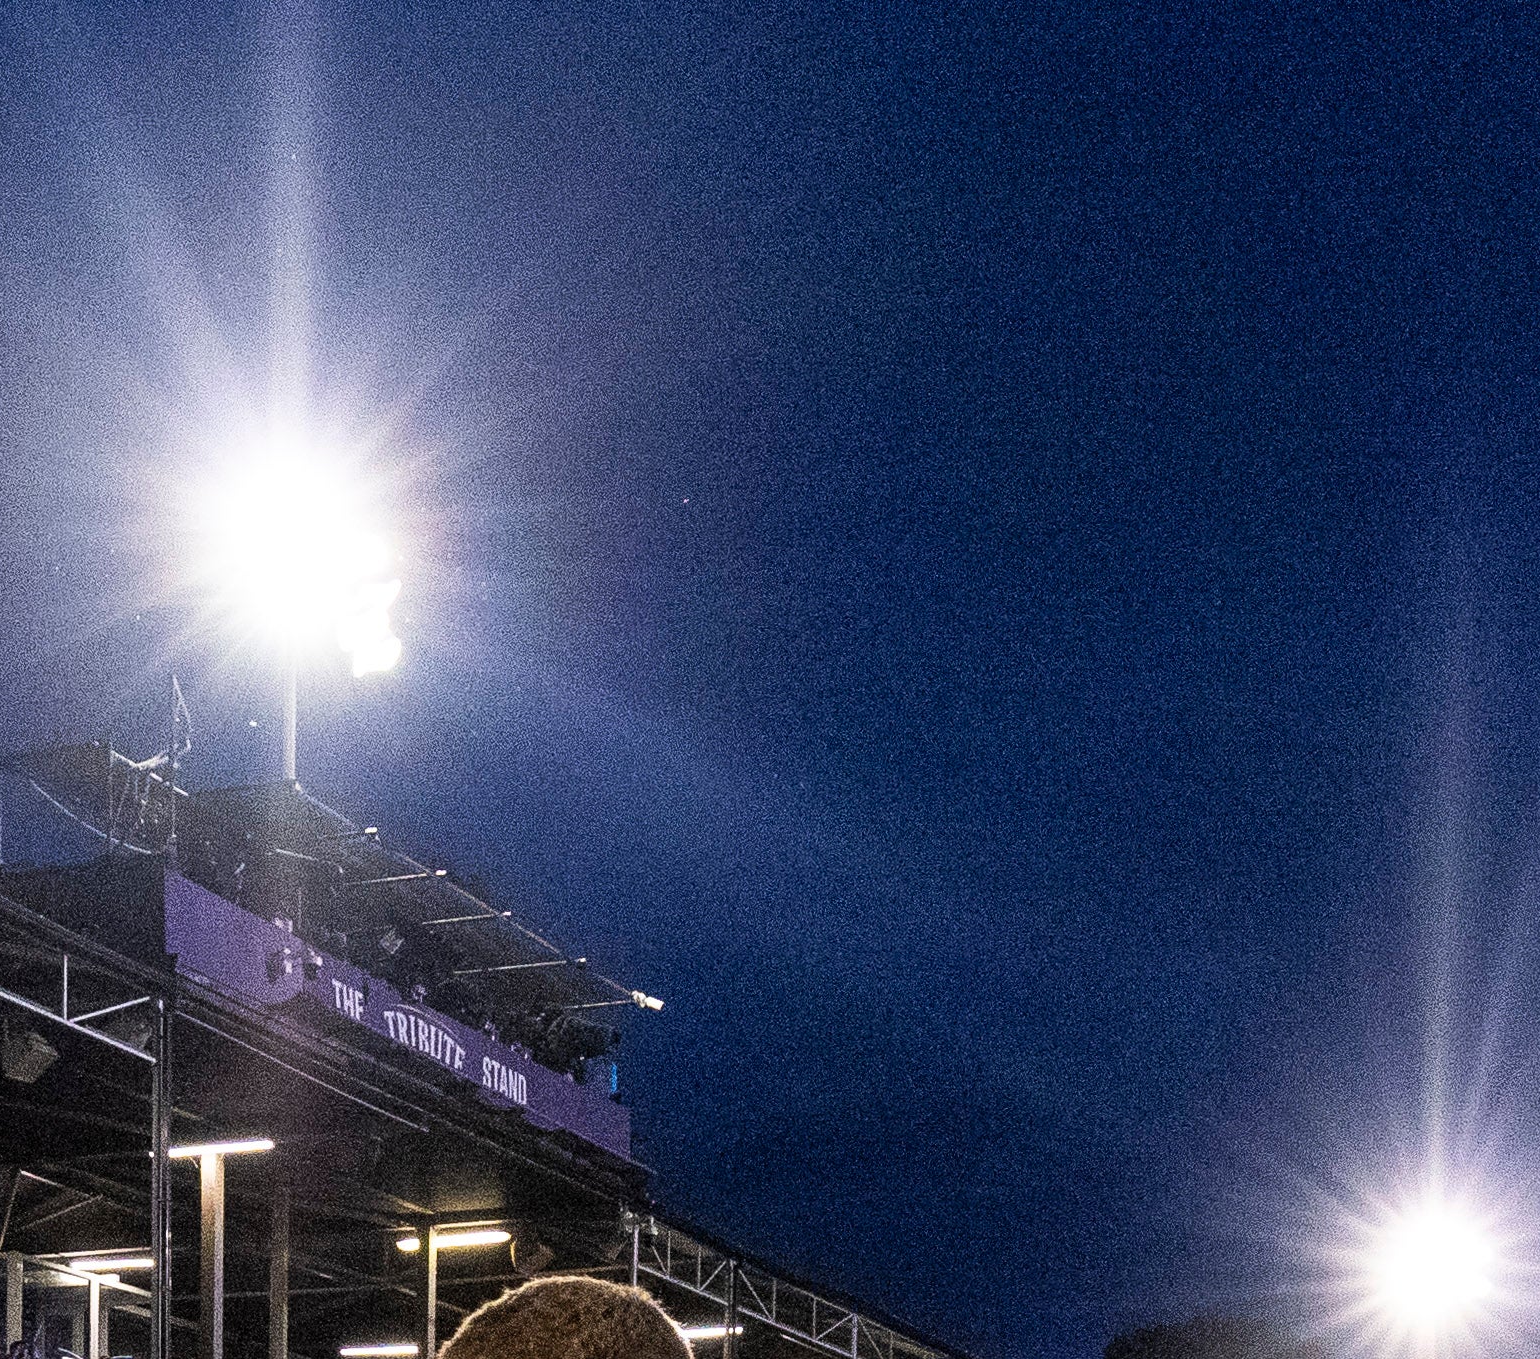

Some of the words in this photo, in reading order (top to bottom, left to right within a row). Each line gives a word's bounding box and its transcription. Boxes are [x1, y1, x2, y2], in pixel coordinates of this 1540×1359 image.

[332, 979, 365, 1021] THE
[383, 1009, 466, 1070] TRIBUTE
[482, 1056, 528, 1105] STAND
